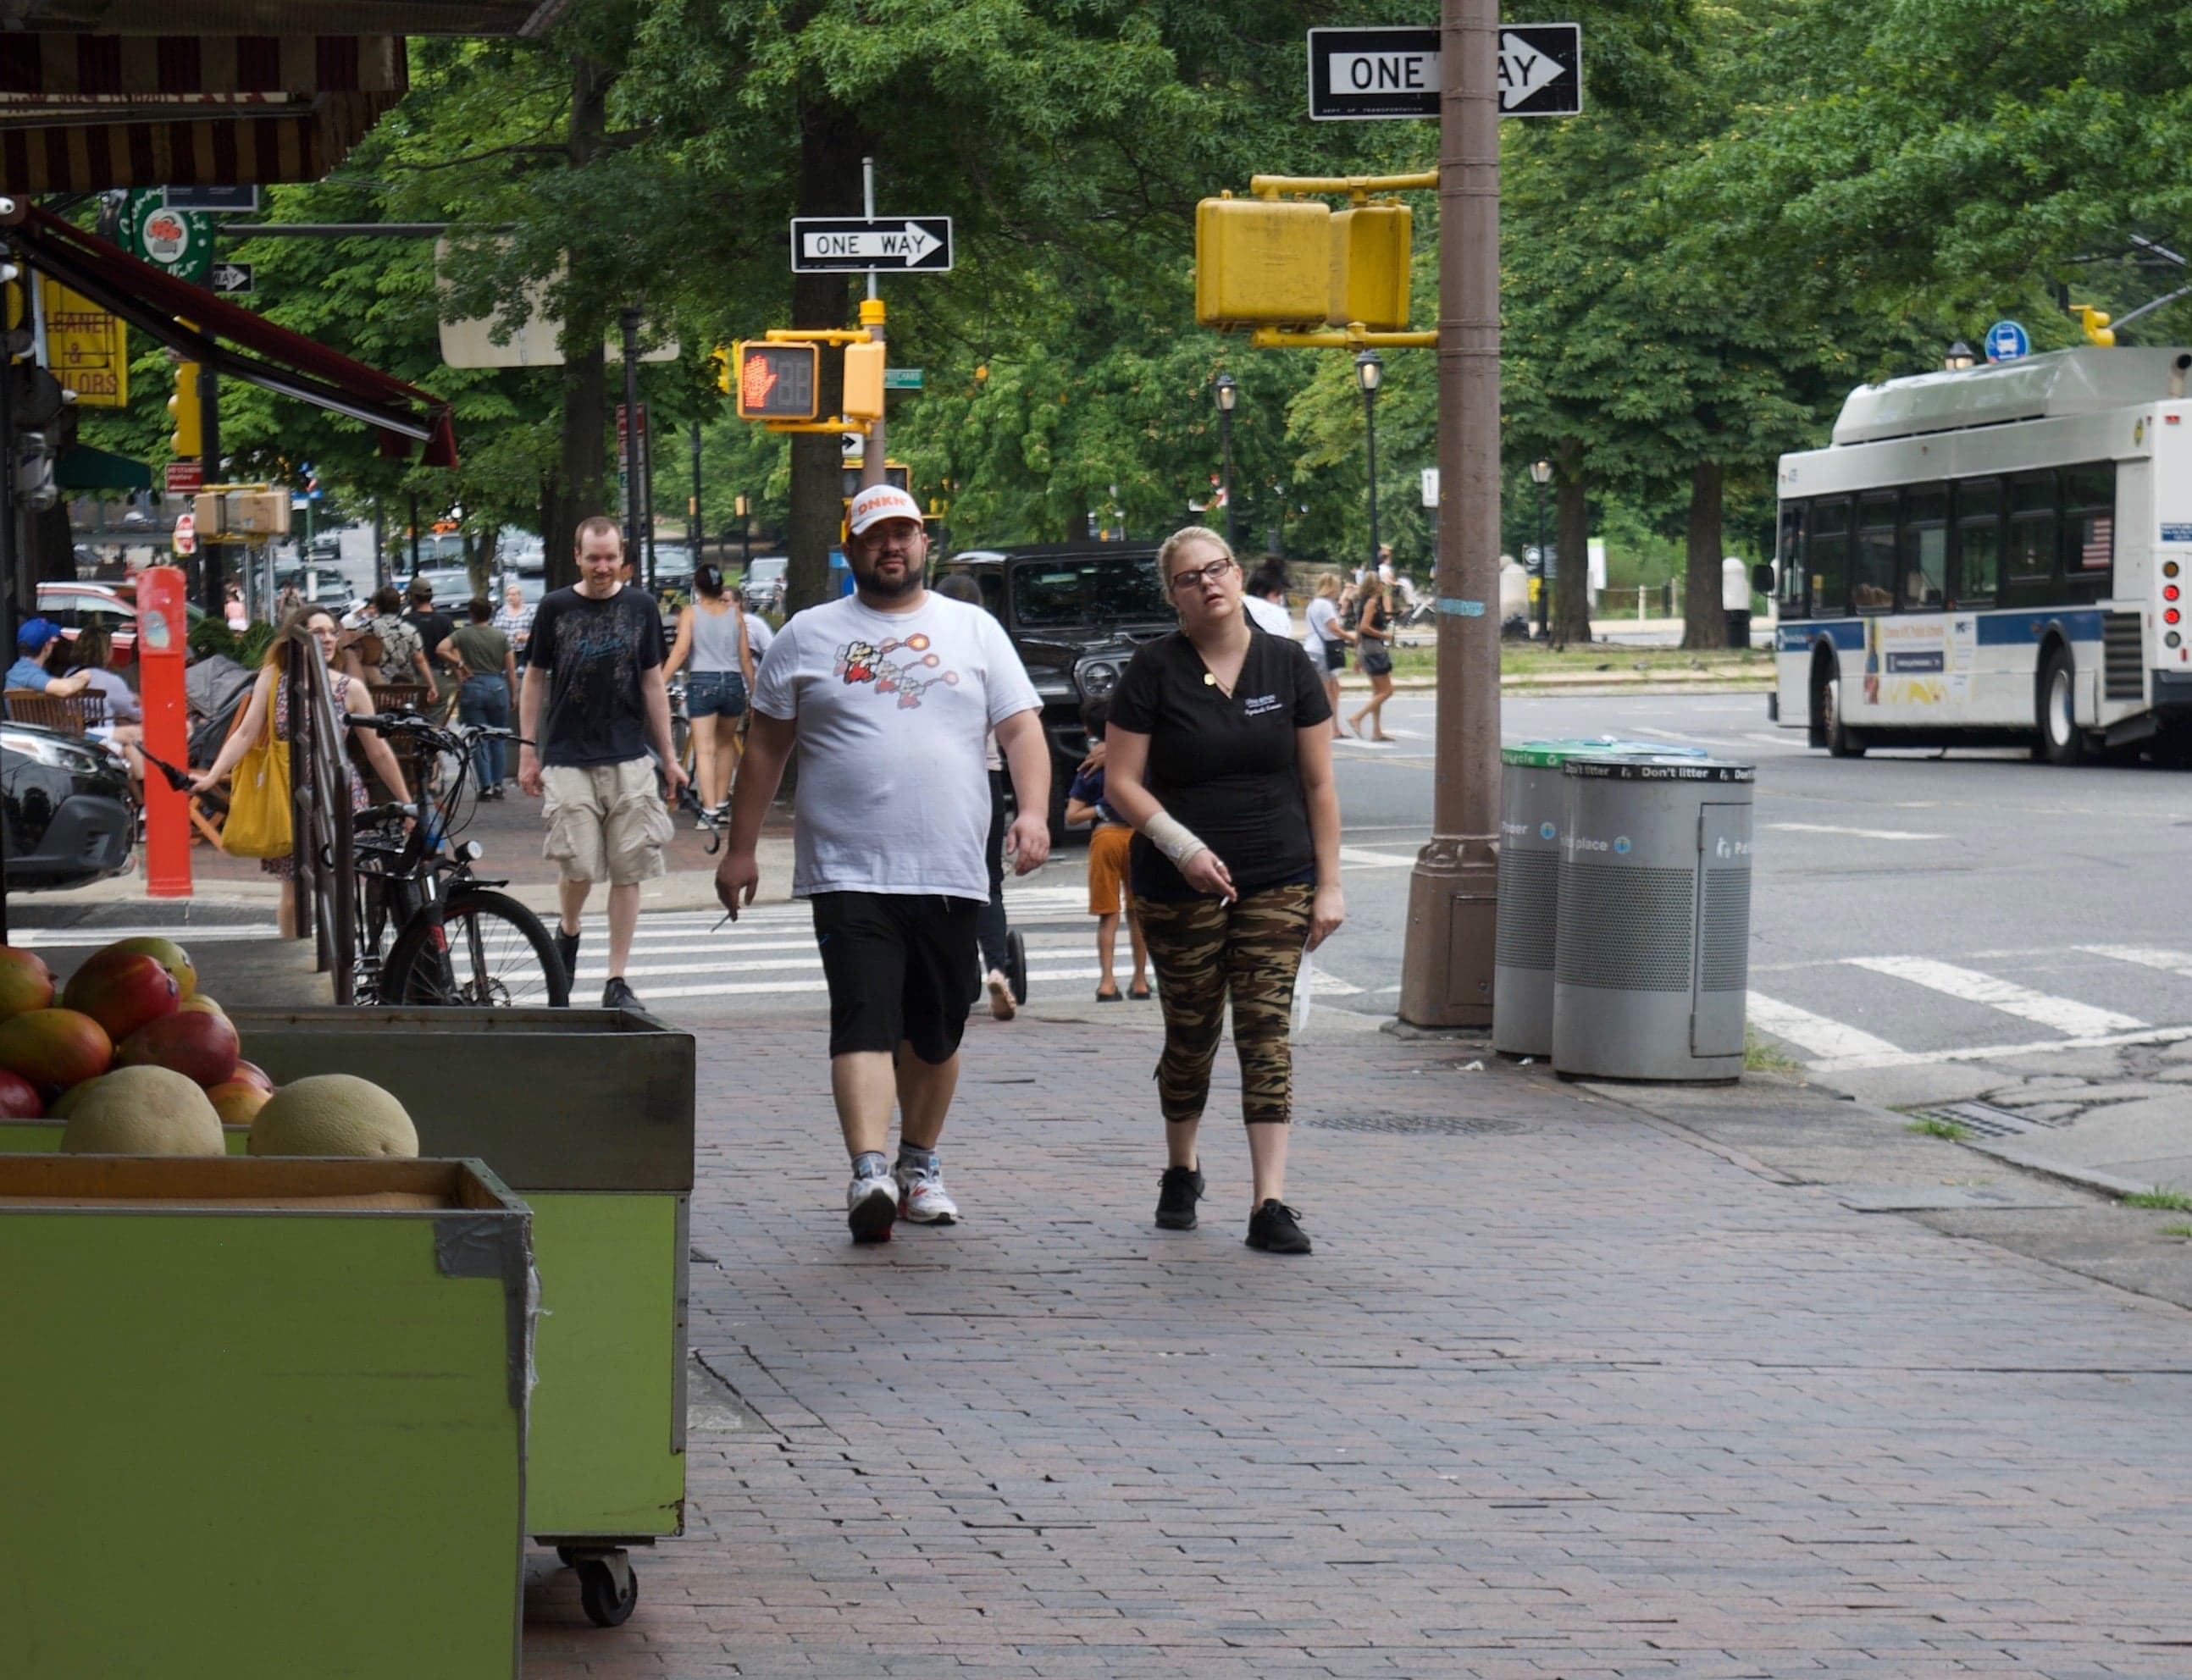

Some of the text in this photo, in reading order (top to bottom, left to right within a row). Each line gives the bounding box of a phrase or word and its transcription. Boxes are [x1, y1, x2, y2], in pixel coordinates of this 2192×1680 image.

[1350, 54, 1537, 90] ONE AY
[816, 235, 927, 255] ONE WAY
[69, 341, 81, 364] &
[1585, 765, 1610, 776] litter
[1641, 766, 1708, 779] Don't litter
[1575, 837, 1609, 851] place
